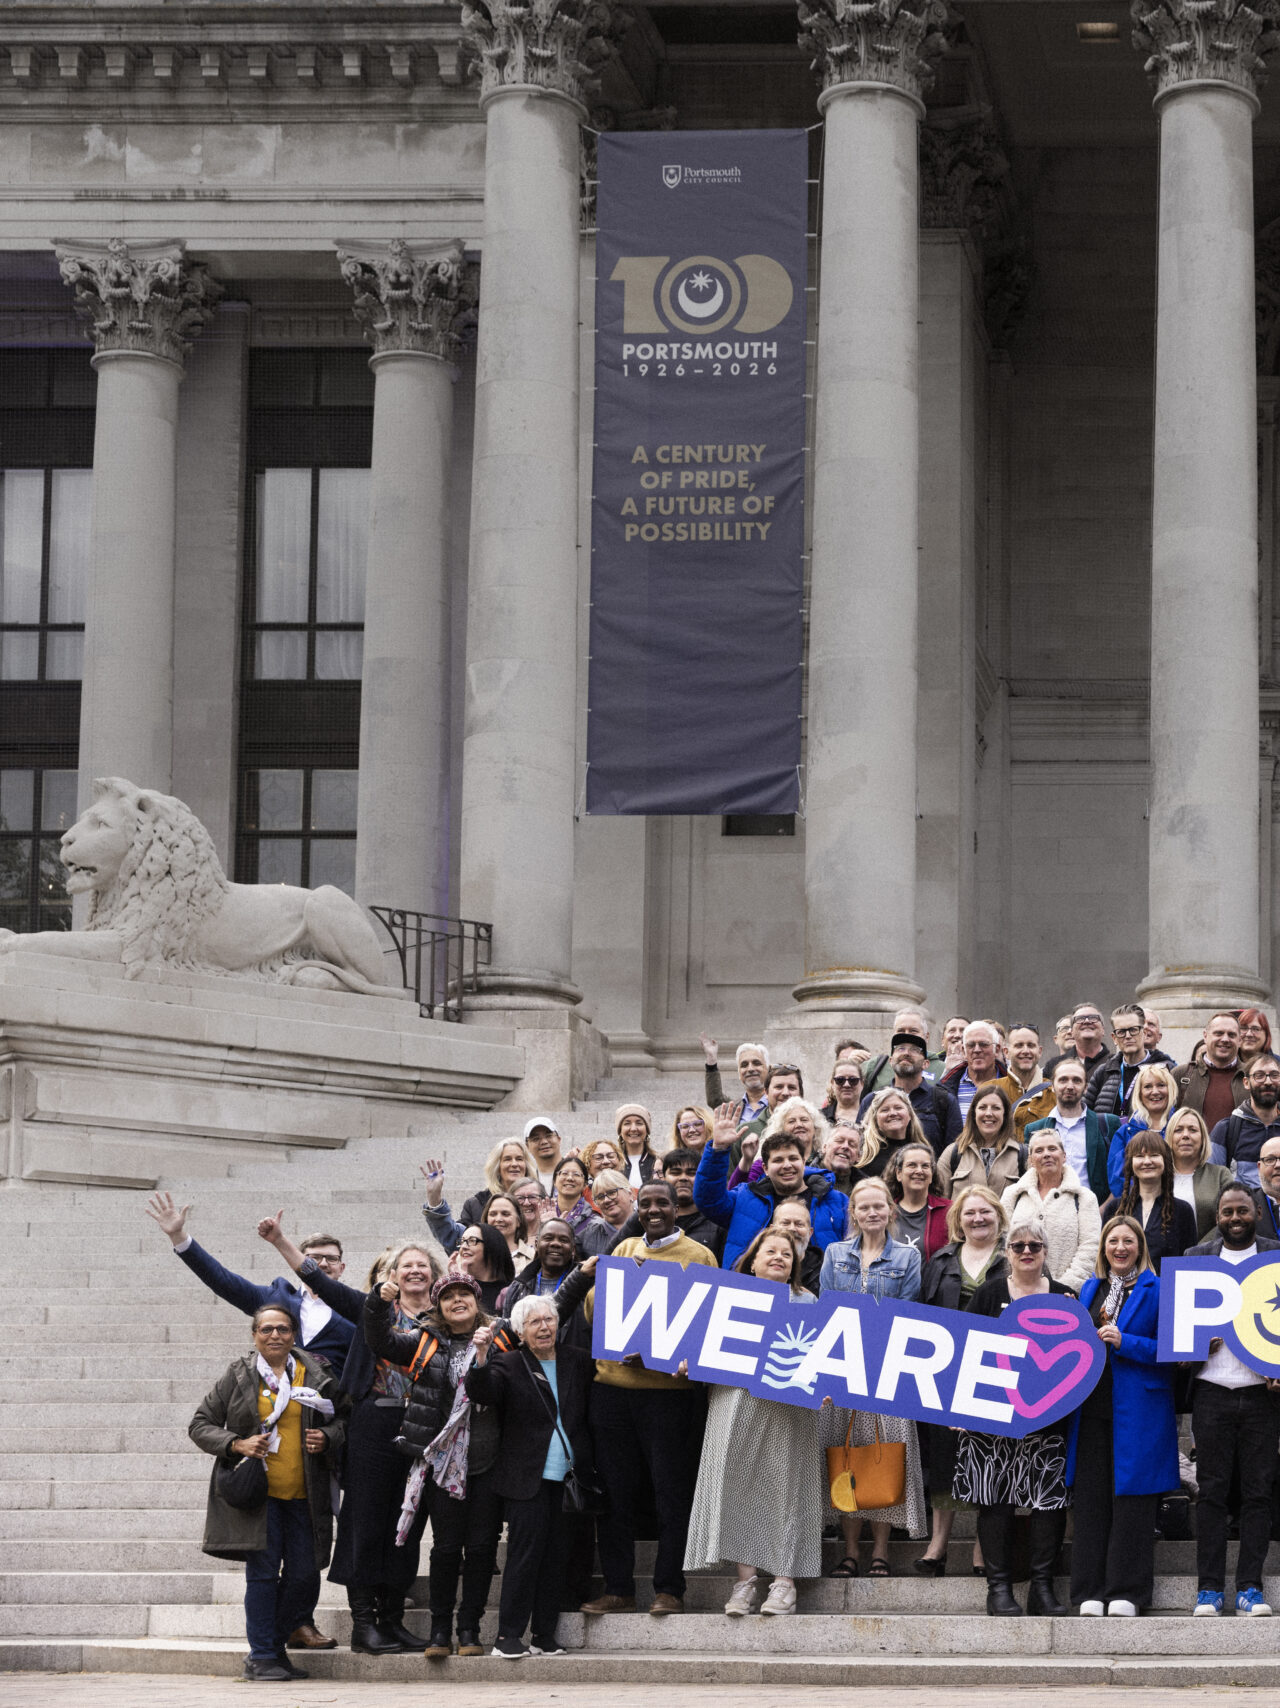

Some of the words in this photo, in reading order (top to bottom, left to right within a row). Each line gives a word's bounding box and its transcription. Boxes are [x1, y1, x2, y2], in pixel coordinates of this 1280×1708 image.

[684, 166, 742, 177] Portsmouth
[610, 254, 793, 334] 100
[622, 342, 777, 360] PORTSMOUTH
[631, 446, 649, 463] A
[656, 444, 766, 463] CENTURY
[640, 472, 673, 489] OF
[680, 470, 756, 491] PRIDE,
[621, 497, 638, 515] A
[645, 496, 735, 515] FUTURE
[742, 496, 775, 514] OF
[625, 522, 771, 541] POSSIBILITY
[604, 1268, 775, 1376] WE
[790, 1306, 1029, 1423] ARE
